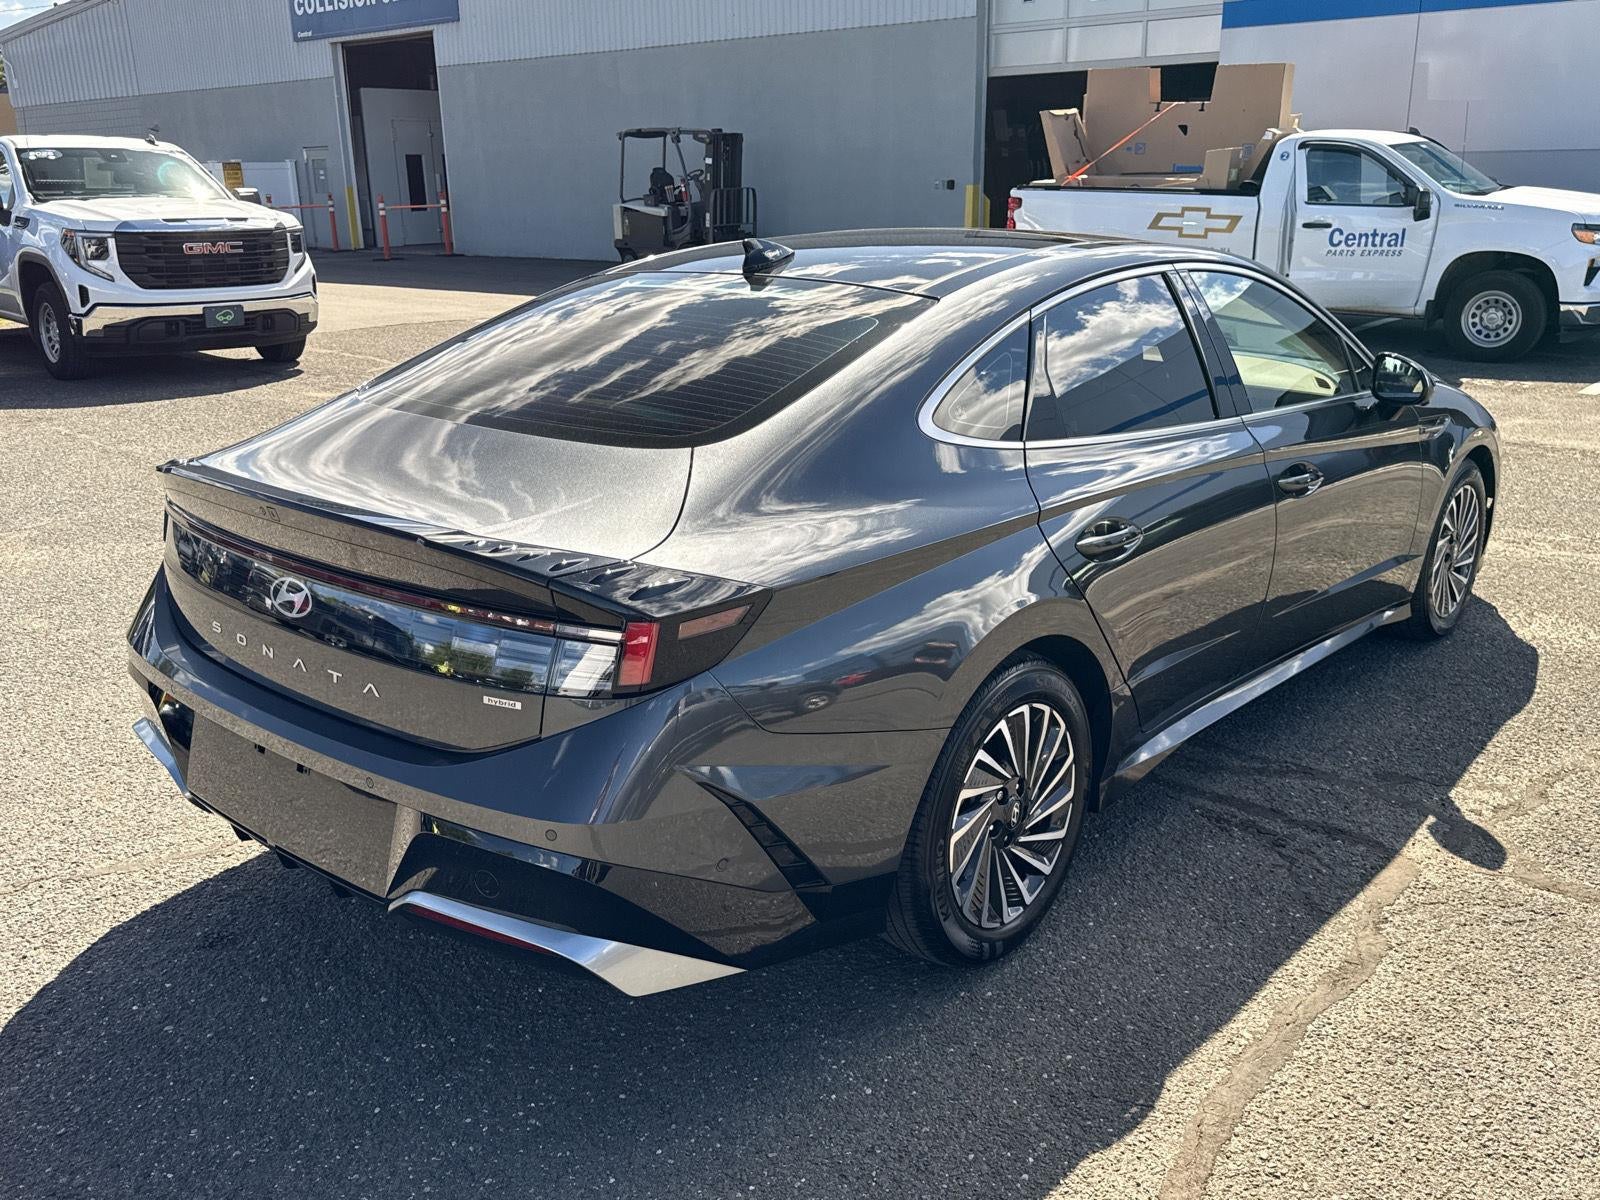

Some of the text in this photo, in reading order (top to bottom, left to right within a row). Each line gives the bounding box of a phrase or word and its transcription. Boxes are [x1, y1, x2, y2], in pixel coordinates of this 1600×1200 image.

[293, 0, 377, 16] COLLIS
[1328, 227, 1406, 248] Central
[183, 241, 244, 255] GMC
[1325, 249, 1403, 257] PARTS EXPRESS
[211, 620, 381, 698] SONATA
[487, 697, 516, 708] hybrid
